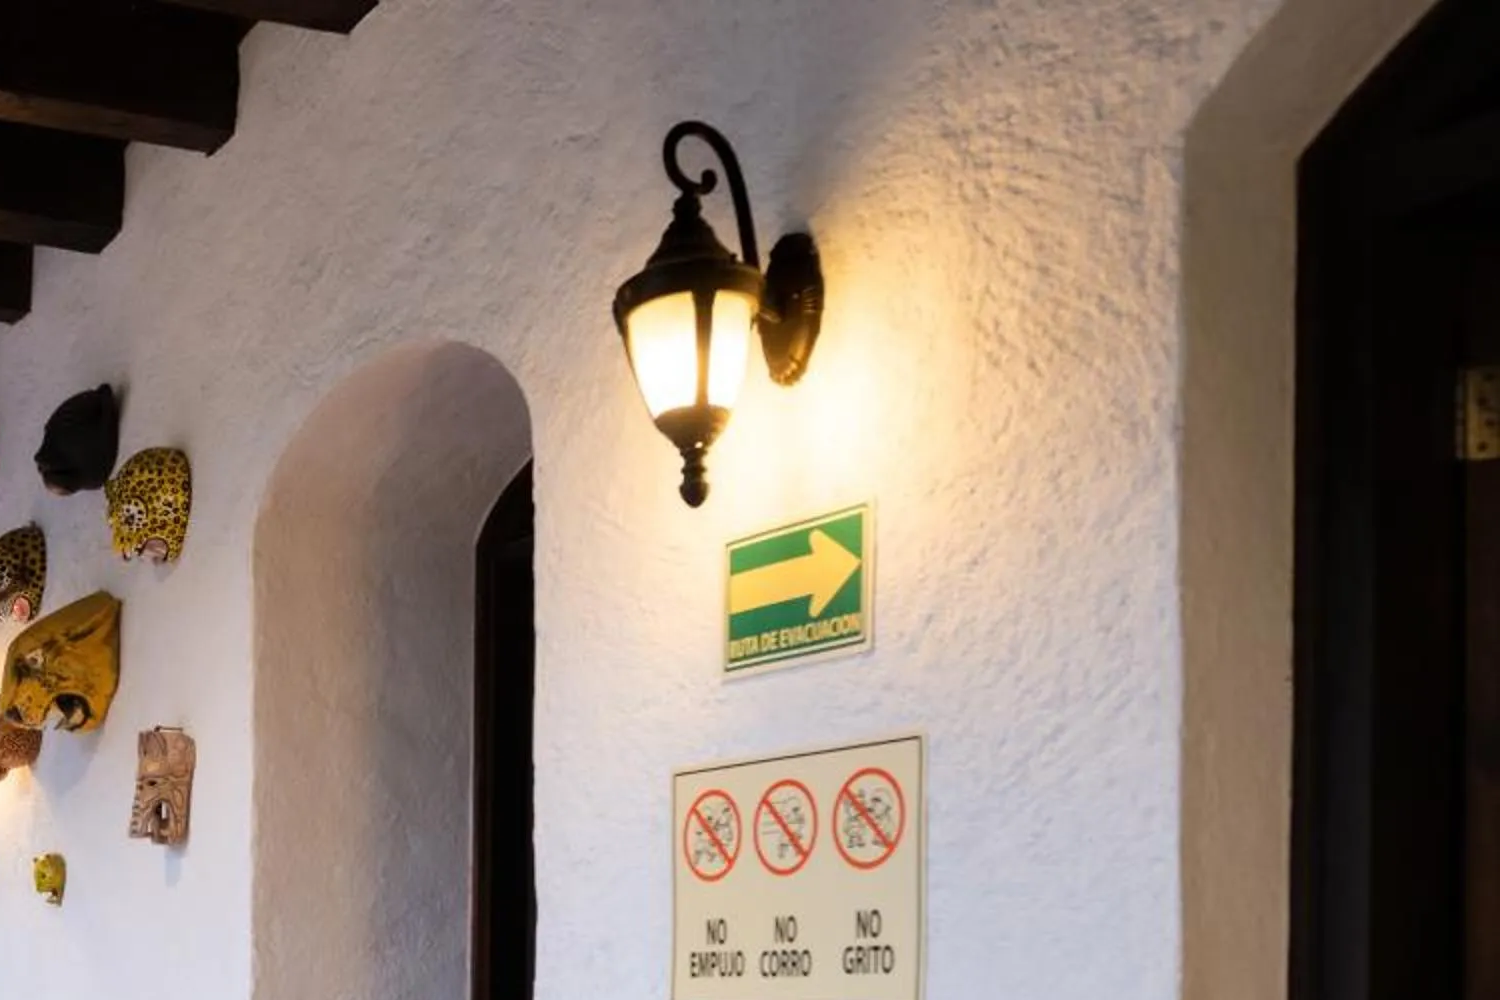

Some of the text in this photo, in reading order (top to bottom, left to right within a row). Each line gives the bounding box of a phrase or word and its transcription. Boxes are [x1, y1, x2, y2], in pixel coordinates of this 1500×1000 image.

[760, 630, 780, 651] DE
[706, 918, 727, 945] NO
[774, 916, 798, 943] NO
[855, 909, 882, 938] NO
[690, 950, 745, 978] EMPUJO
[760, 949, 812, 977] CORRO
[842, 945, 895, 975] GRITO
